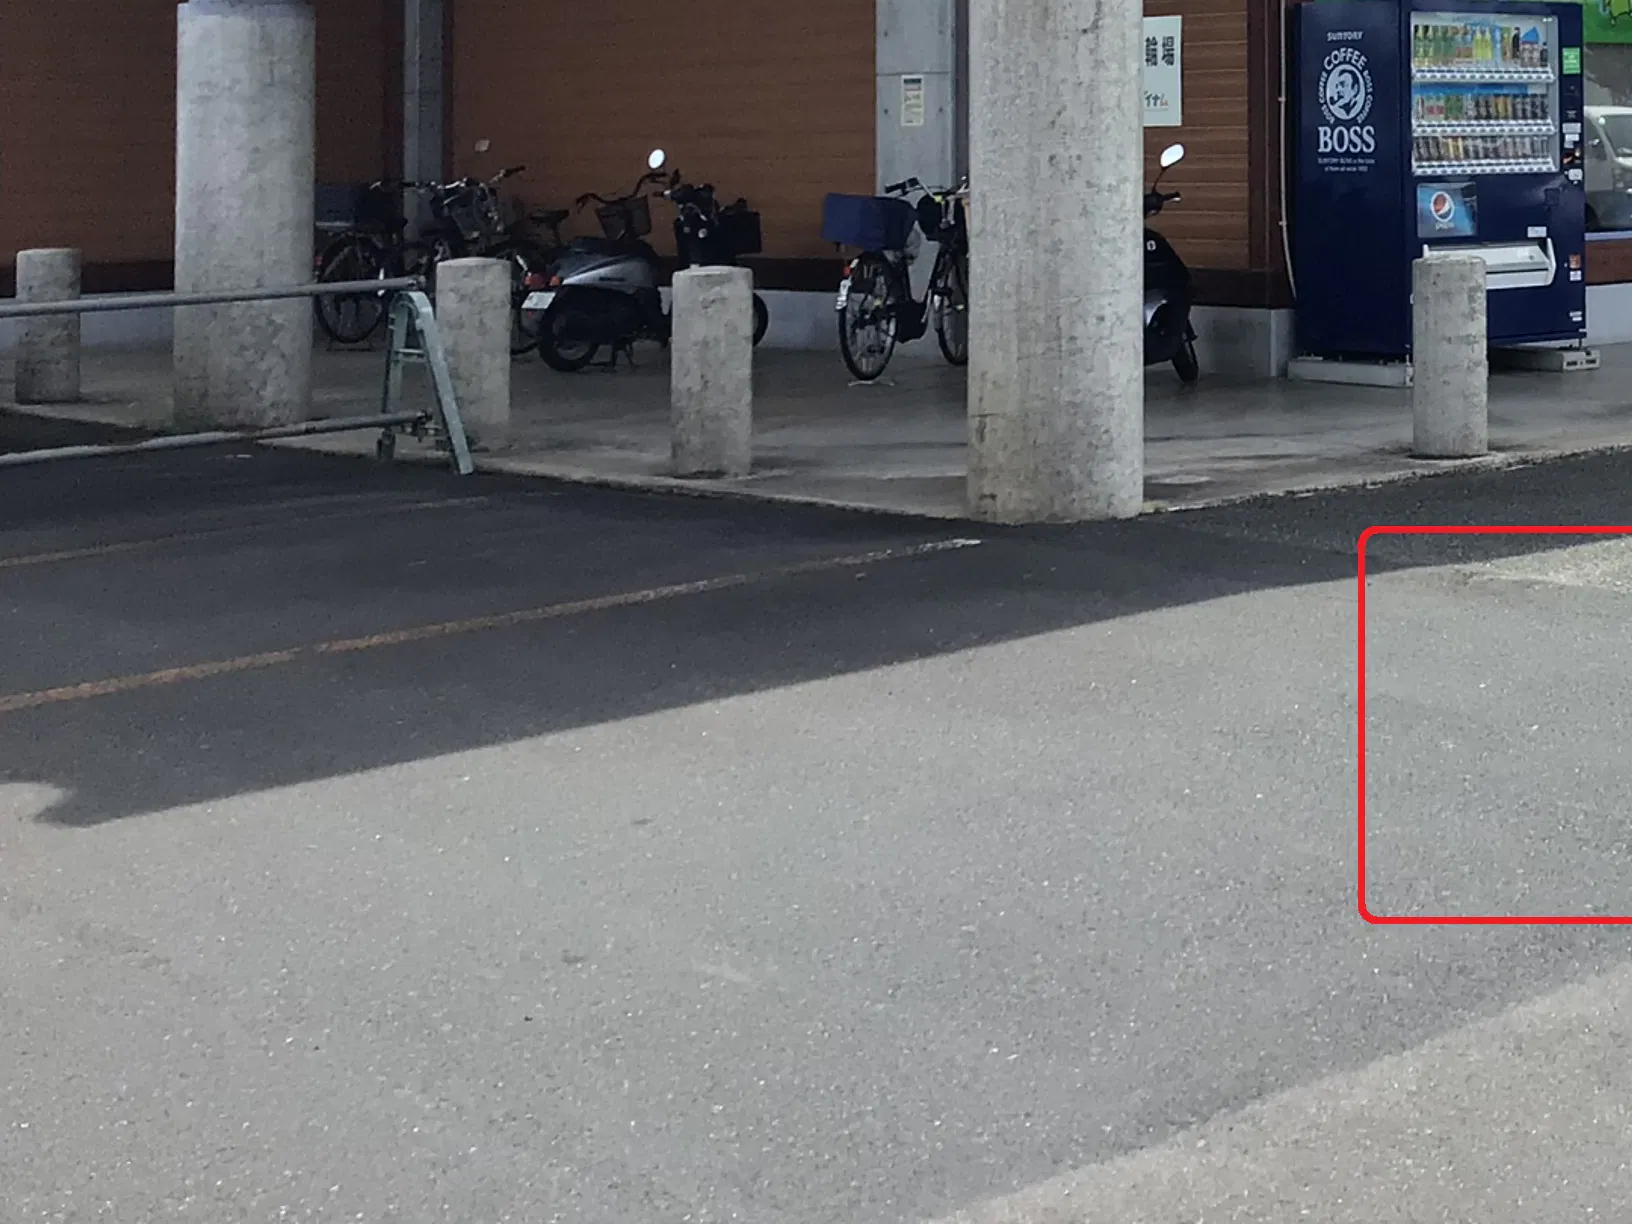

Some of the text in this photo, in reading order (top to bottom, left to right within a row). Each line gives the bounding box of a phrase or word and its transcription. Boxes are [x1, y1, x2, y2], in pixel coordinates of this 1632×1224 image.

[1326, 31, 1363, 41] SUNTORY
[1323, 47, 1368, 70] COFFEE
[1317, 125, 1376, 154] BOSS
